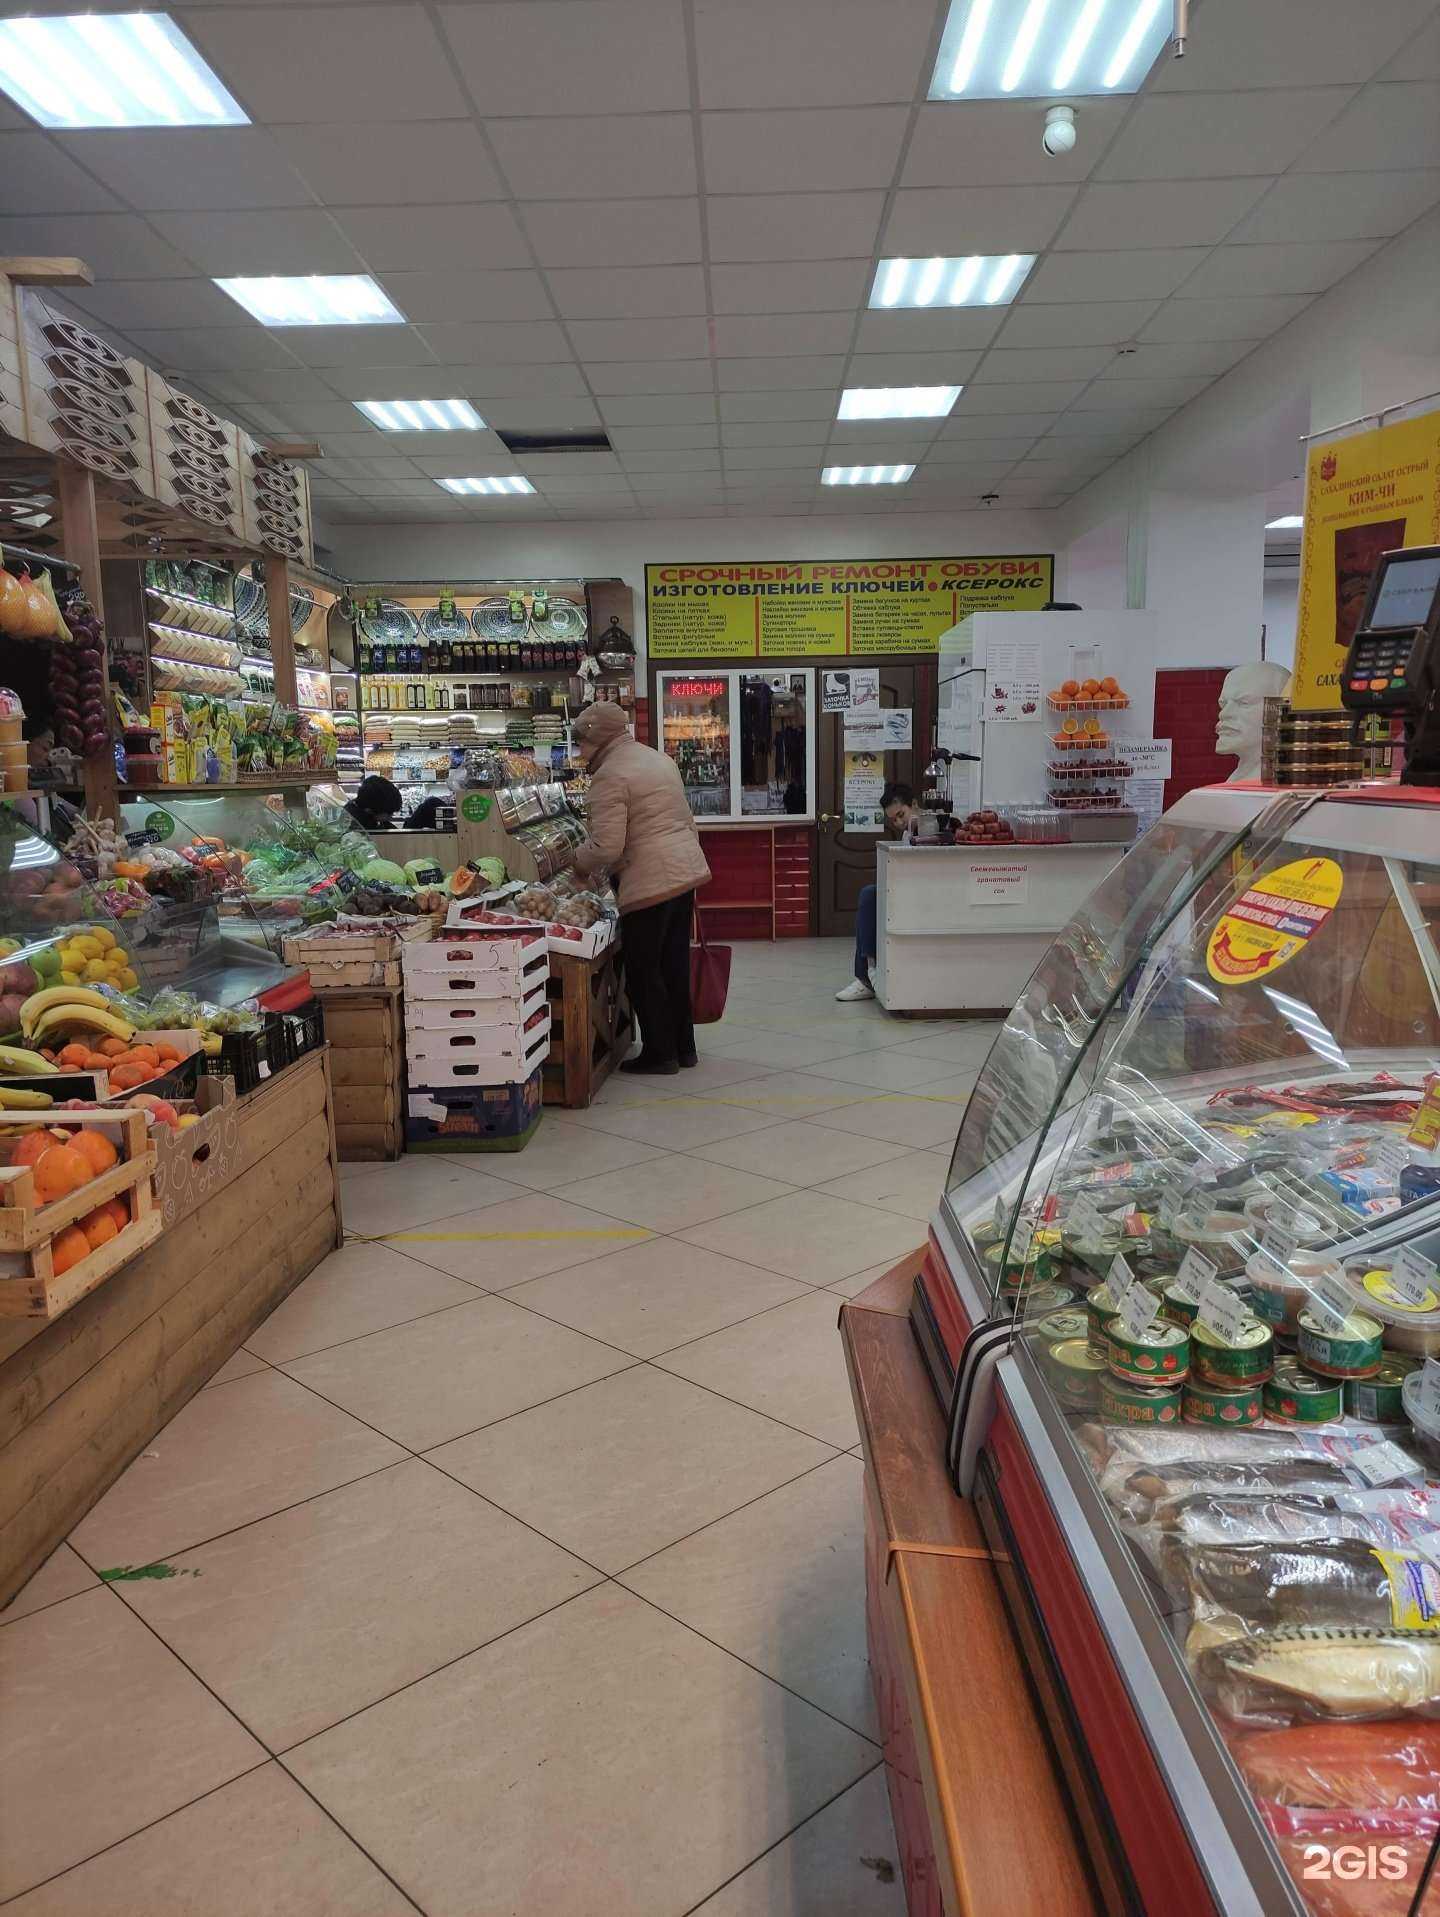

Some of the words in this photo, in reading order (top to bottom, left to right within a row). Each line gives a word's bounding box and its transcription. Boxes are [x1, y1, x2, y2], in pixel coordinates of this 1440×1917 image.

[1348, 483, 1396, 506] КИМ-ЧИ
[659, 563, 803, 583] СРОЧНЫЙ
[811, 564, 933, 580] РЕМОНТ
[940, 561, 1041, 578] ОБУВИ
[652, 582, 824, 597] ИЗГОТОВЛЕНИЕ
[831, 578, 925, 594] КЛЮЧЕЙ
[940, 576, 1044, 591] КСЕРОКС
[671, 683, 724, 697] КЛЮЧИ
[970, 865, 1028, 873] Свежевыжатый
[976, 876, 1021, 884] гранатовый
